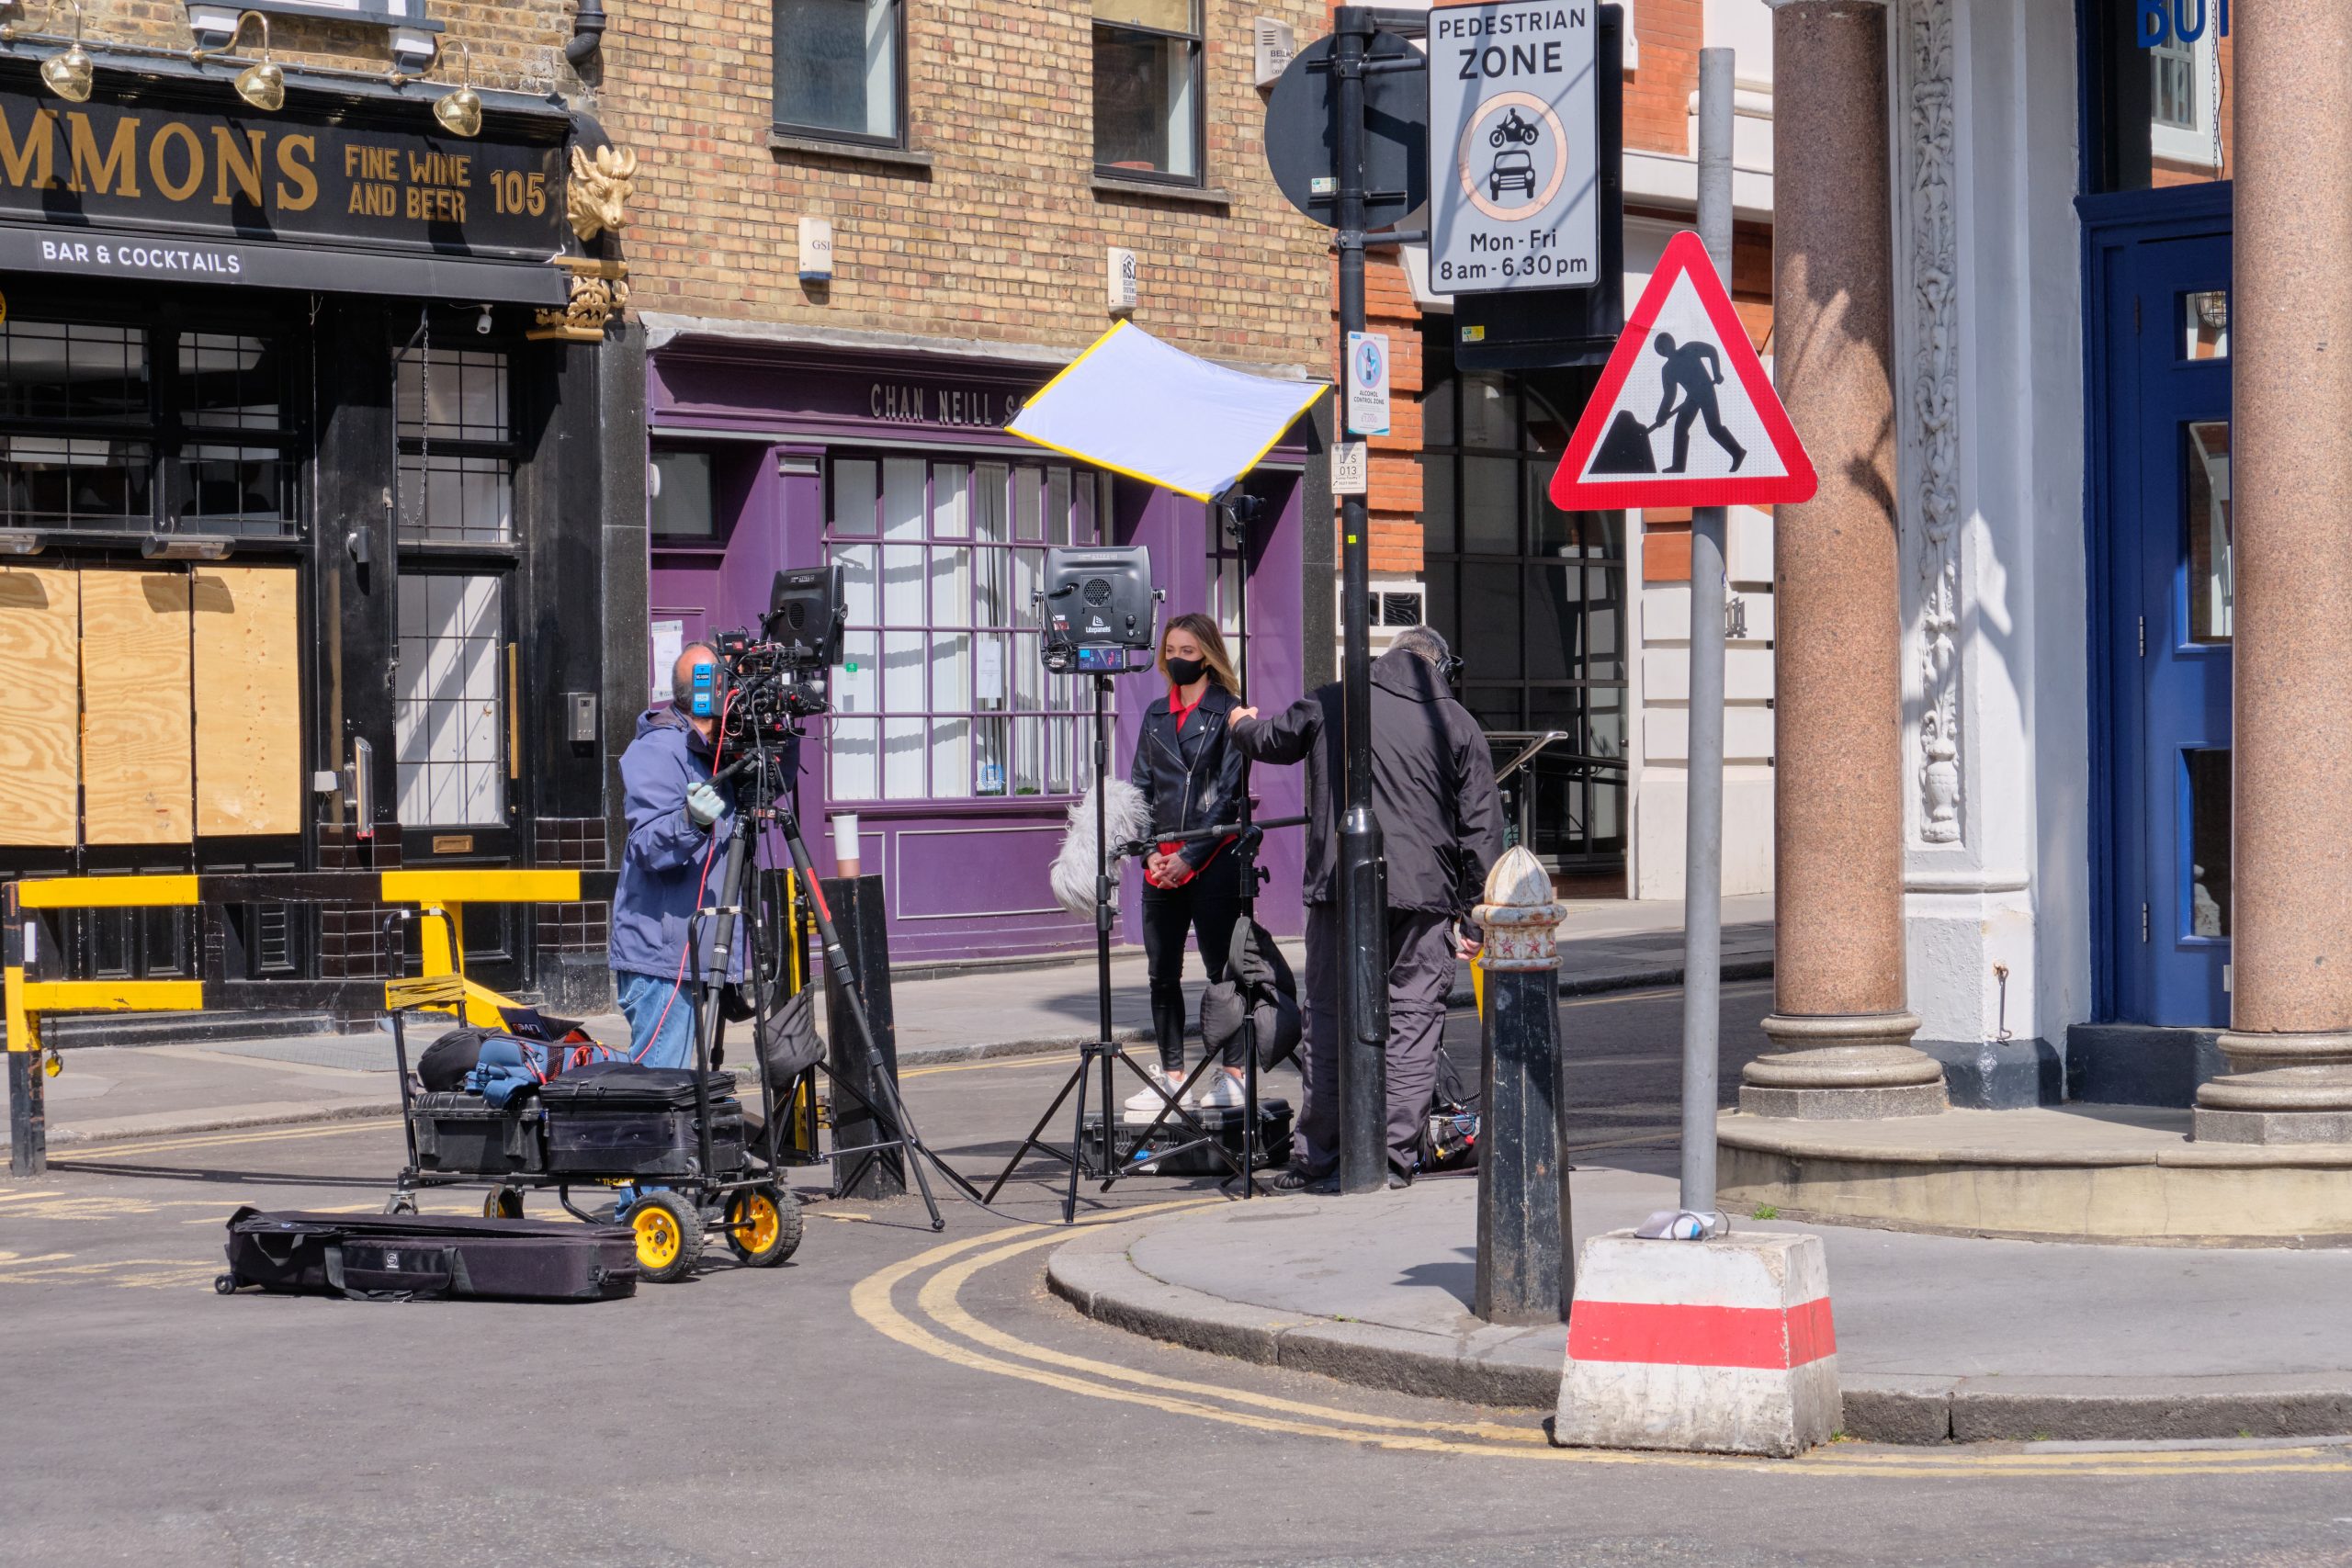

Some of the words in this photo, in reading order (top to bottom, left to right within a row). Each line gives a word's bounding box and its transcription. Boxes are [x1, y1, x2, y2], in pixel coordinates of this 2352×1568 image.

[1439, 8, 1586, 39] PEDESTRIAN
[1459, 41, 1564, 80] ZONE
[345, 144, 401, 181] FINE
[408, 152, 471, 188] WINE
[348, 182, 397, 217] AND
[406, 187, 467, 223] BEER
[490, 169, 546, 217] 105
[41, 240, 88, 263] BAR
[96, 244, 110, 264] &
[119, 246, 241, 275] COCKTAILS
[1470, 236, 1514, 253] Mon
[1530, 229, 1556, 249] Fri
[870, 382, 924, 420] CHAN
[939, 389, 992, 425] NEILL
[1353, 396, 1373, 404] CONTROL
[1359, 389, 1378, 398] ALCOHOL
[1340, 466, 1357, 476] 013
